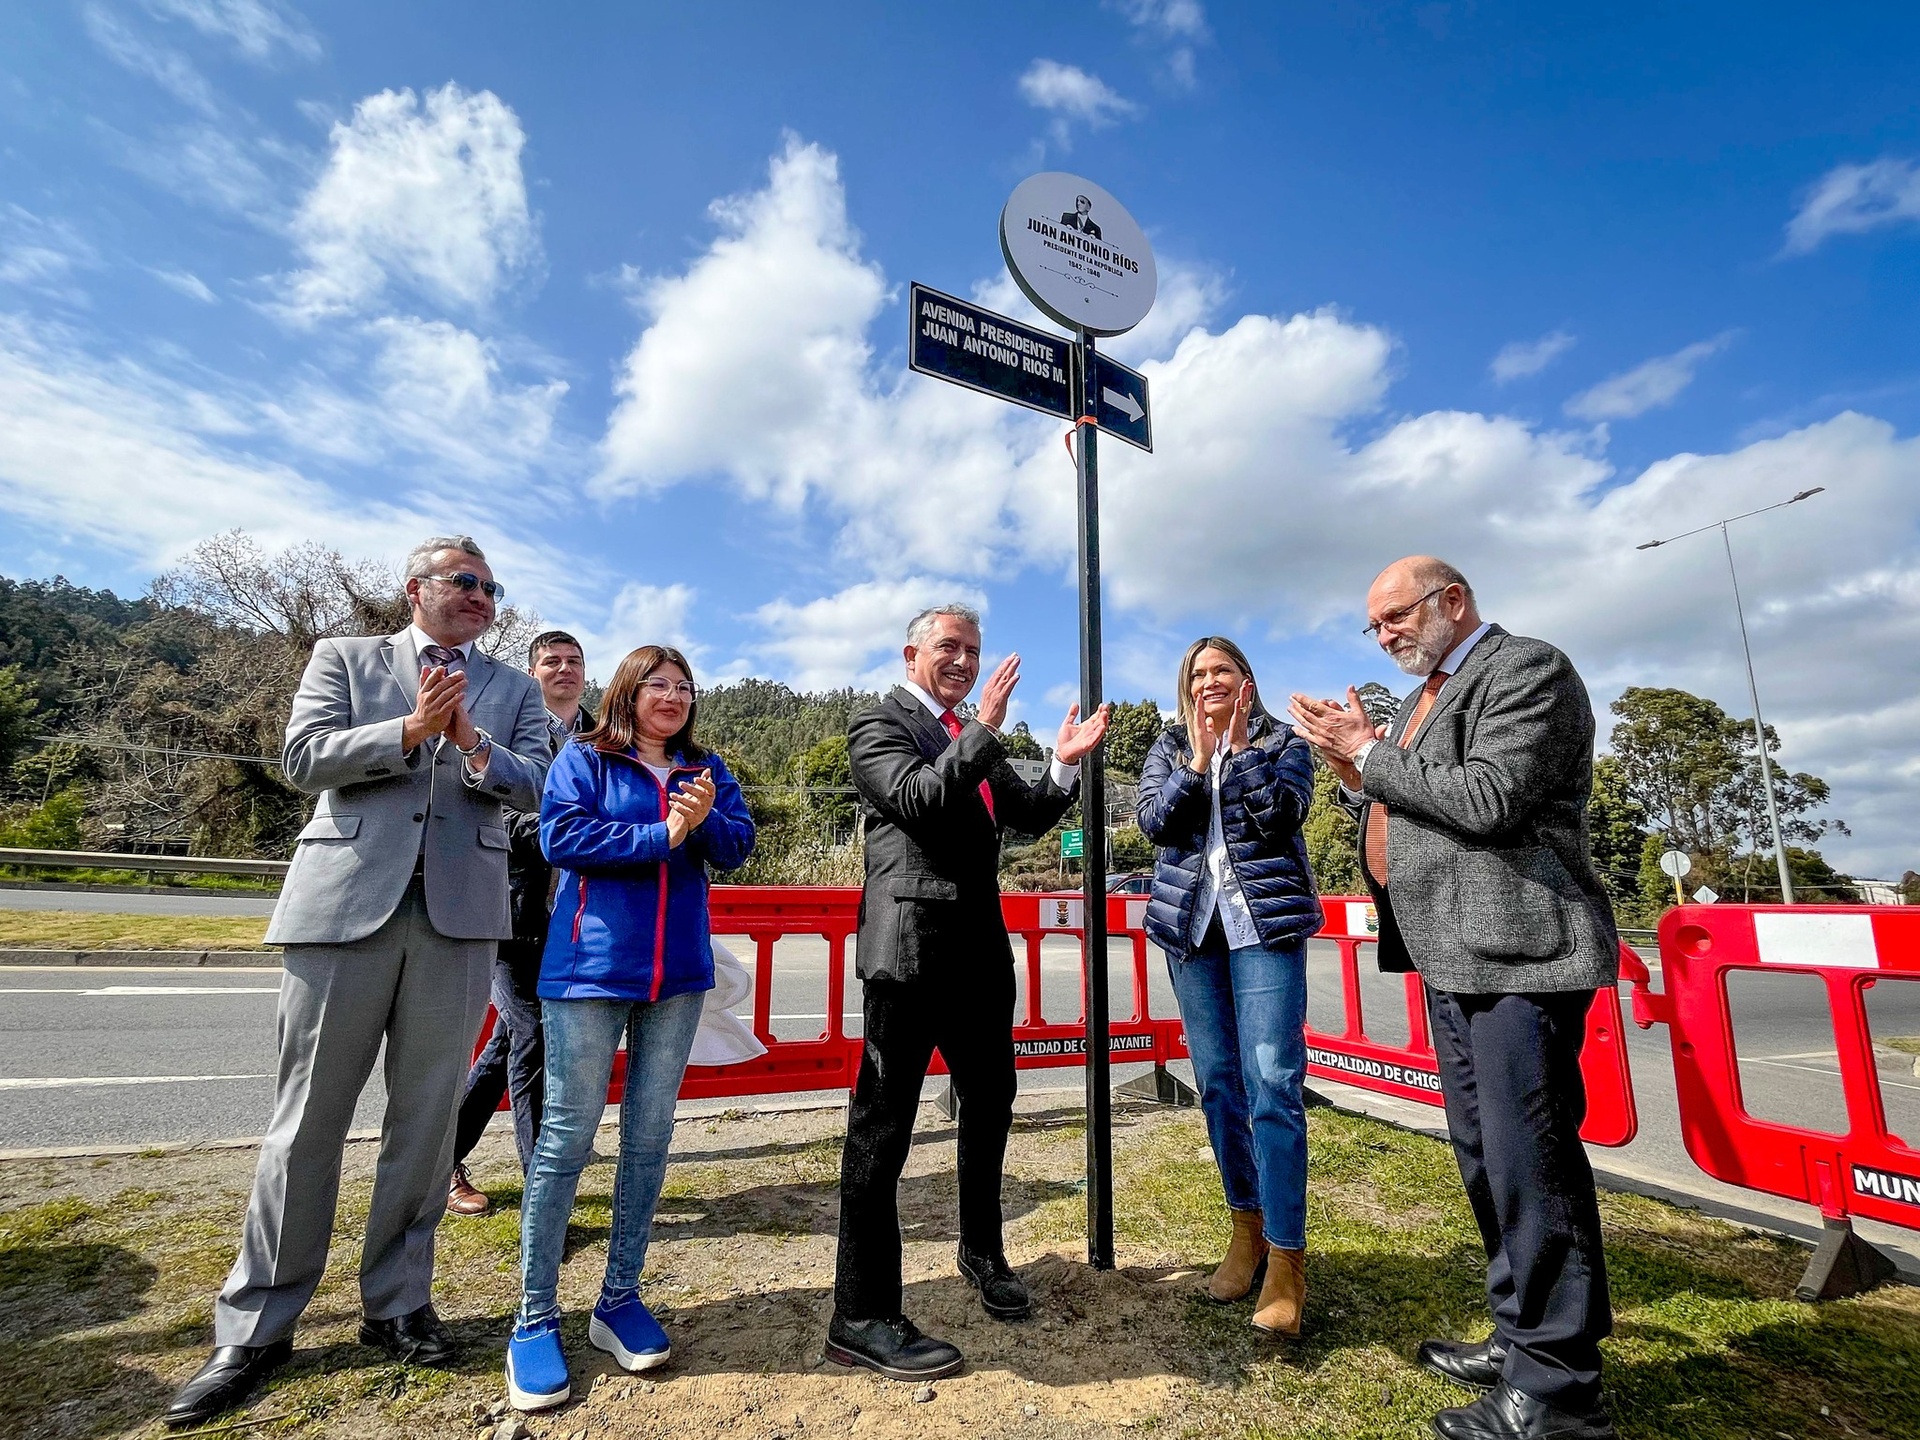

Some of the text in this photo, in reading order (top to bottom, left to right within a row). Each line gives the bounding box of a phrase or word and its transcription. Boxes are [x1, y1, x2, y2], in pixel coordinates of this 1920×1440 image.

[1027, 218, 1139, 274] JUAN ANTONIO RÍOS
[1043, 239, 1077, 259] PRESIDENTE
[1078, 253, 1086, 262] DE
[1086, 256, 1094, 265] LA
[921, 301, 1054, 363] AVENIDA PRESIDENTE
[921, 321, 1067, 385] JUAN ANTONIO RIOS M.
[1063, 1040, 1078, 1053] DE
[1384, 1064, 1402, 1082] DE
